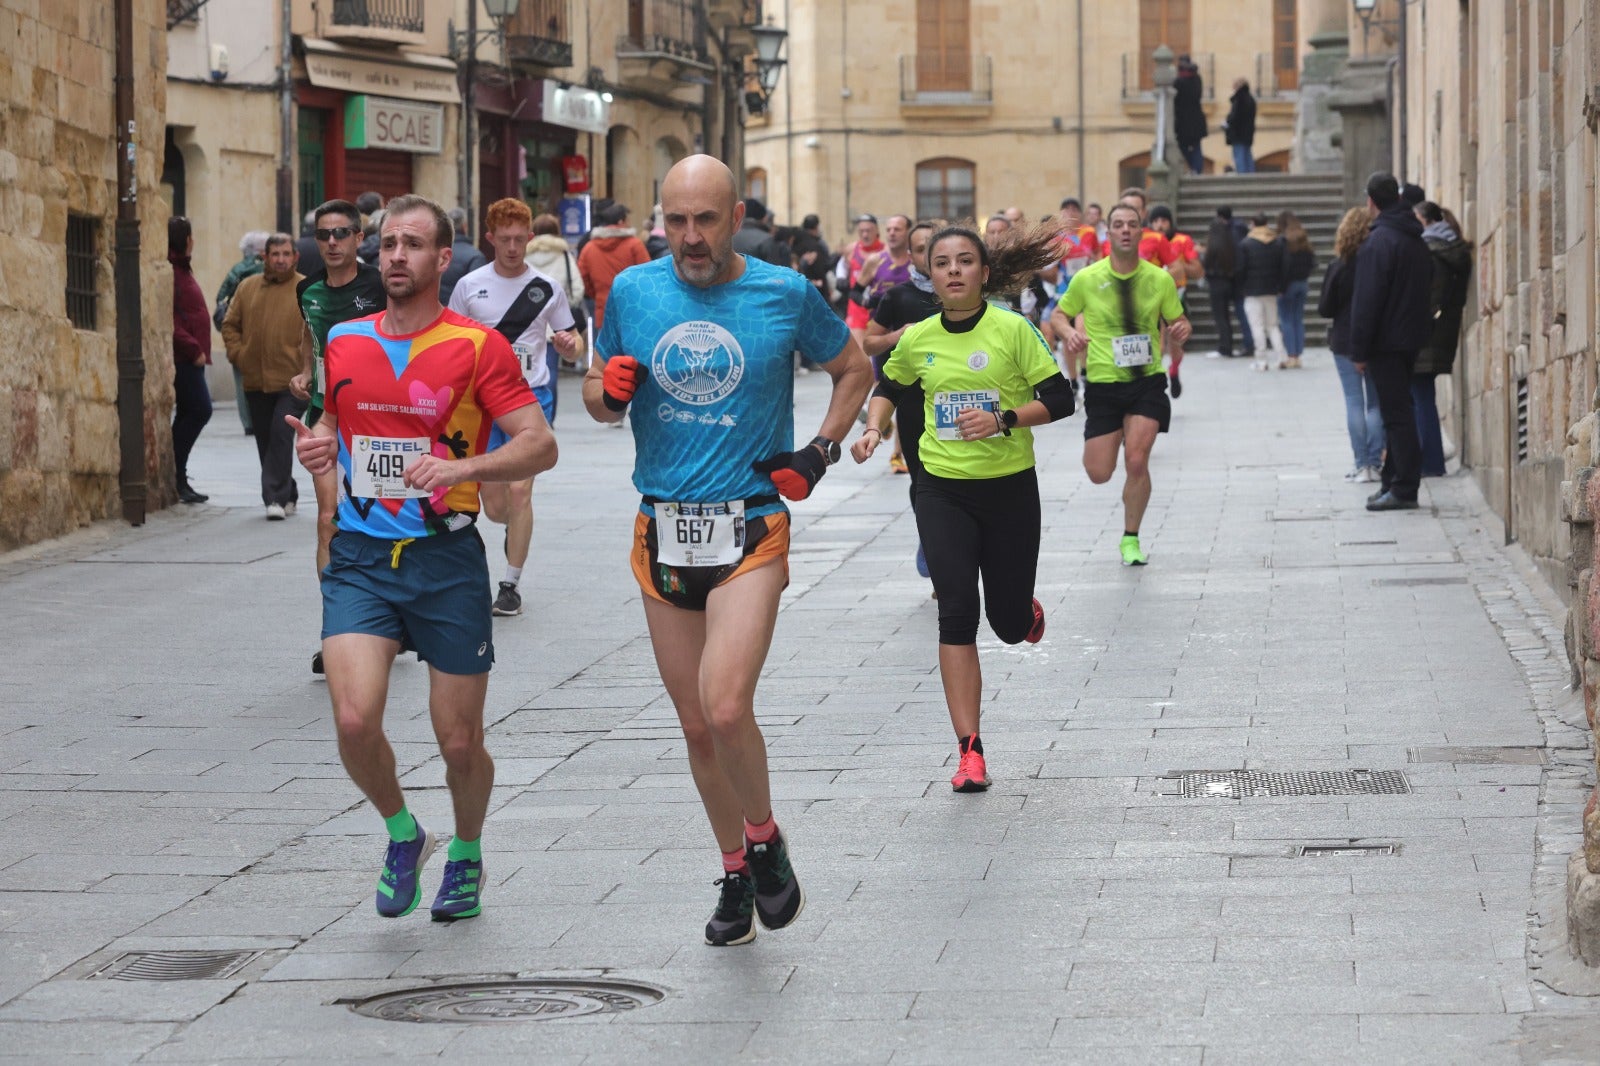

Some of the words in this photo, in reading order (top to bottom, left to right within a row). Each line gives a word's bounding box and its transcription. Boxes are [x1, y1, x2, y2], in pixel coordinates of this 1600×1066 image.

[376, 111, 431, 146] SCALE
[1122, 343, 1141, 356] 644
[418, 399, 437, 407] XXXIX
[697, 393, 716, 402] DEL
[950, 393, 992, 401] SETEL
[357, 402, 369, 411] SAN
[370, 403, 398, 413] SILVESTRE
[400, 405, 437, 416] SALMANTINA
[371, 440, 423, 452] SETEL
[367, 453, 404, 478] 409
[676, 519, 715, 544] 667
